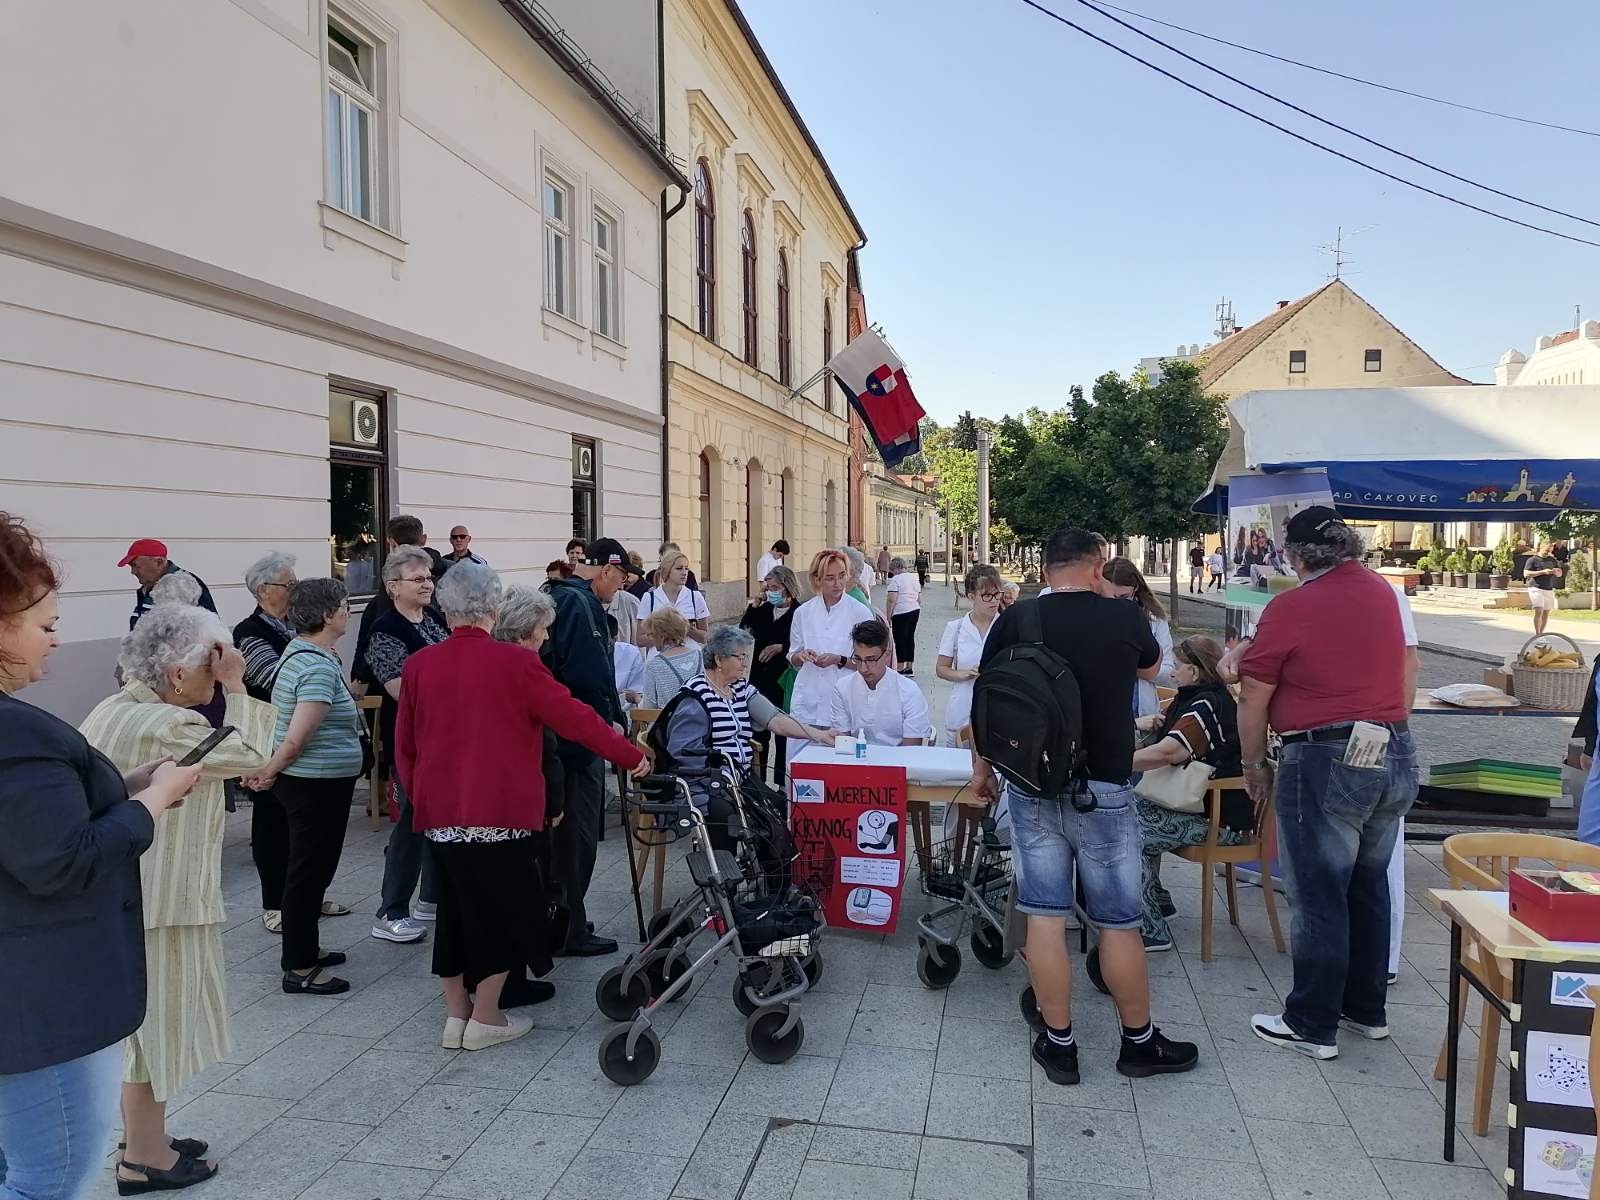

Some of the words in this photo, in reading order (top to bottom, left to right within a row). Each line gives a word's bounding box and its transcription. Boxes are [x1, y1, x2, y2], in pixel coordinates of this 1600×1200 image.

[1333, 491, 1352, 499] AD
[826, 787, 897, 806] MJERENJE
[793, 818, 852, 843] KRVNOG
